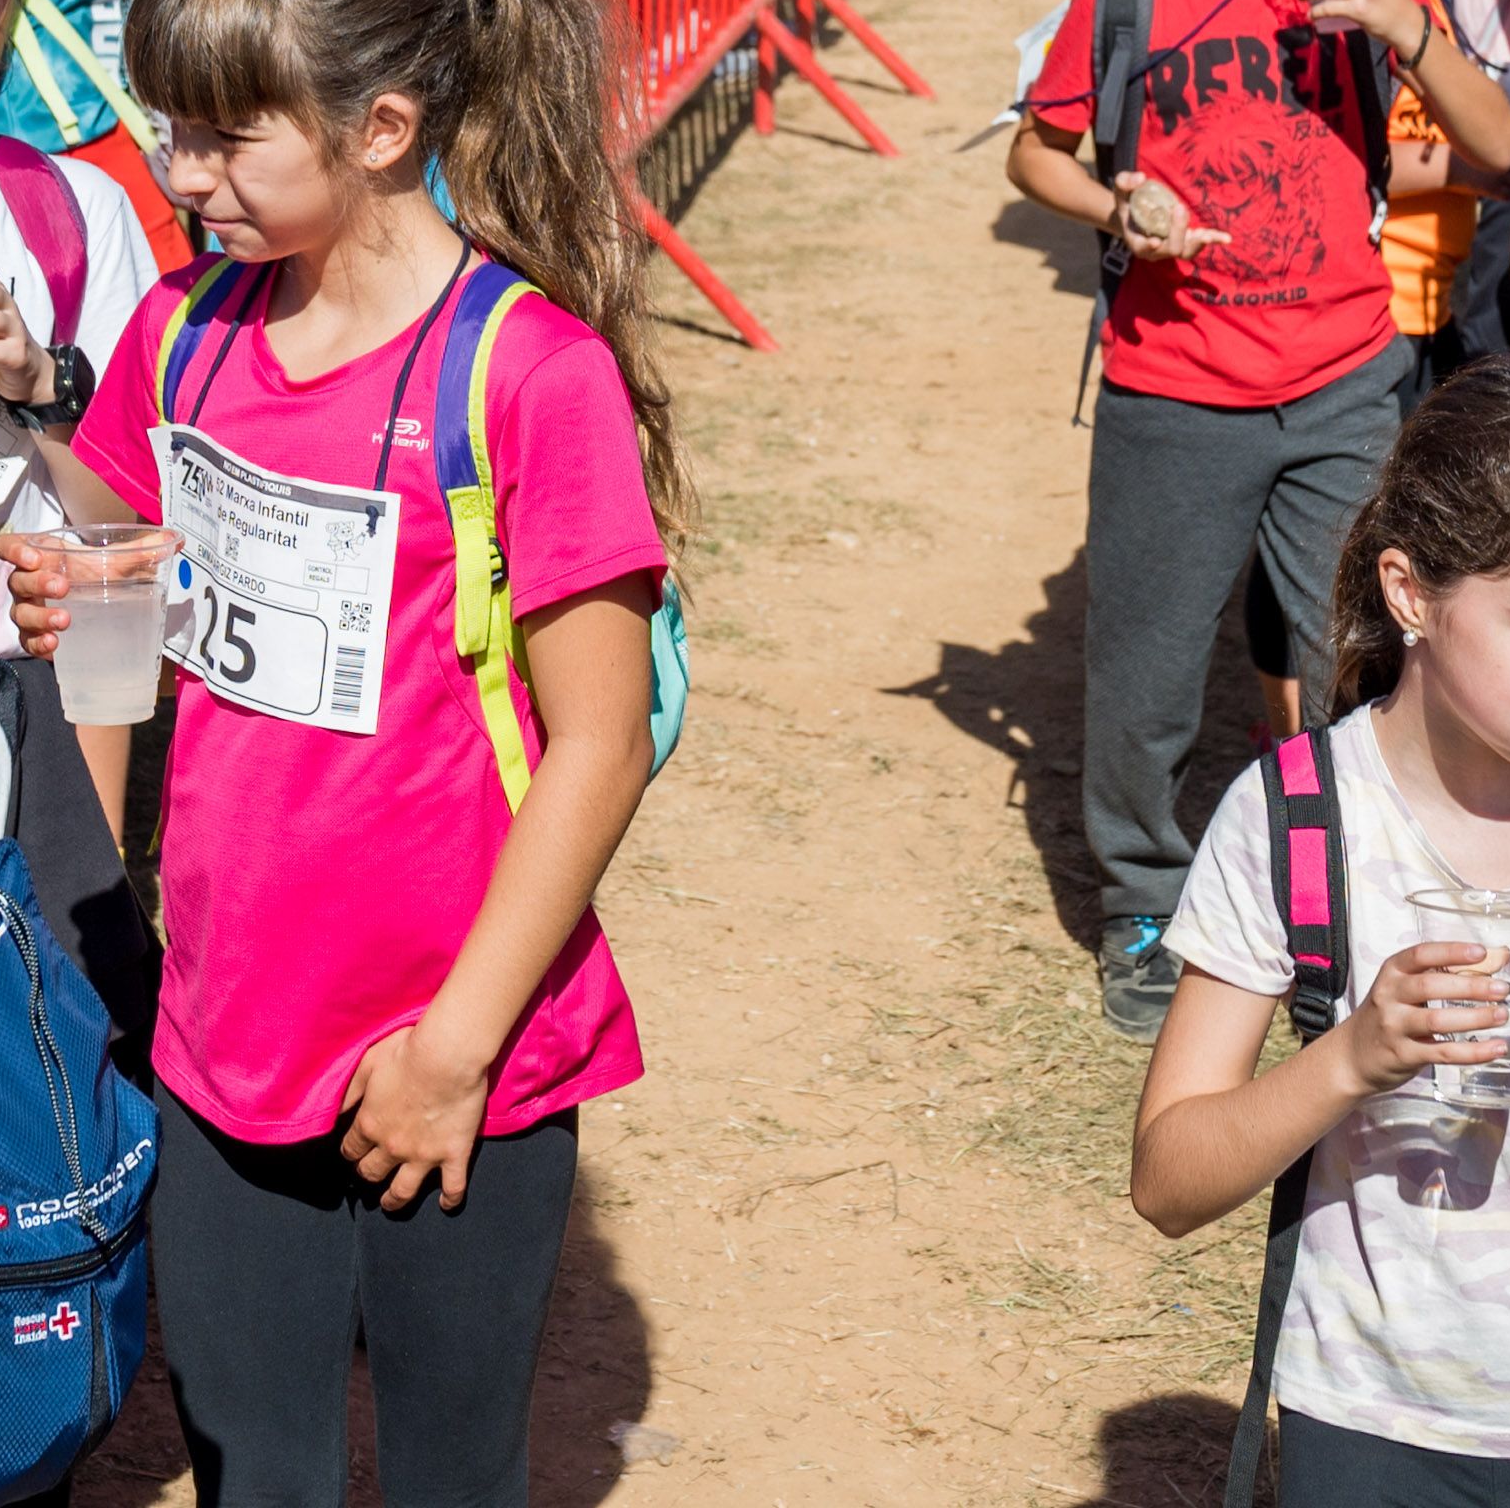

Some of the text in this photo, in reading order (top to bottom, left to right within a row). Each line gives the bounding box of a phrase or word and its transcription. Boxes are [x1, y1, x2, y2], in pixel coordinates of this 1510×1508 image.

[1147, 32, 1344, 135] REBEL
[372, 432, 430, 452] Klenji
[215, 477, 226, 495] 52
[226, 484, 256, 513] Marxa
[258, 501, 309, 528] Infantil
[217, 505, 228, 523] de
[229, 515, 298, 551] Regularitat
[232, 570, 267, 595] PARDO
[199, 585, 256, 684] 25
[17, 1213, 51, 1230] 100%
